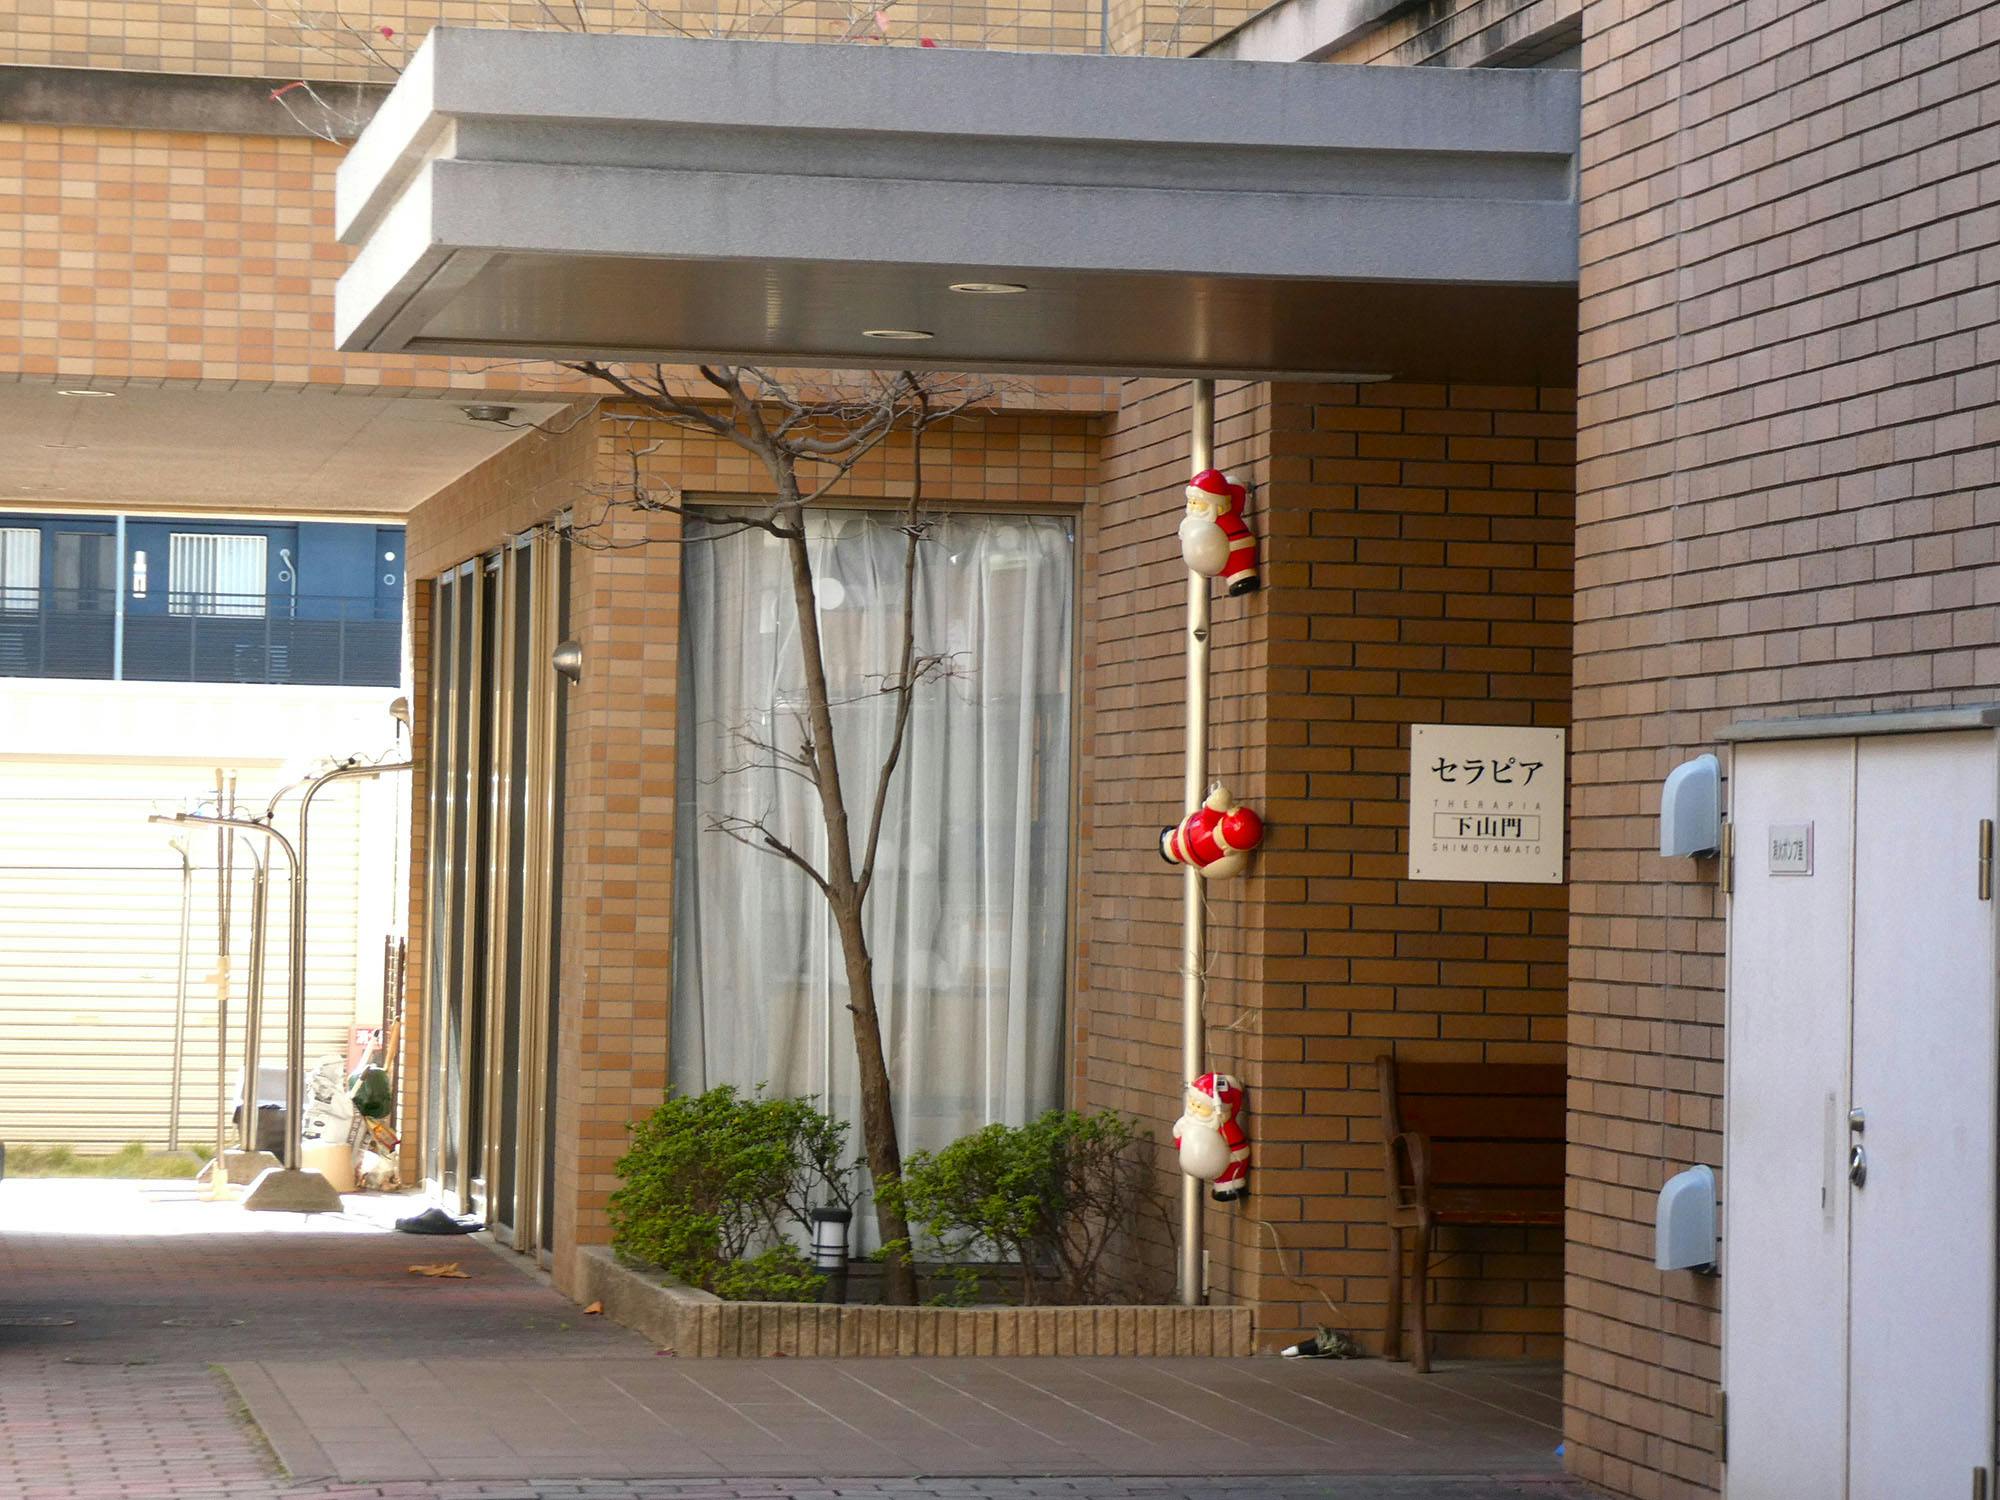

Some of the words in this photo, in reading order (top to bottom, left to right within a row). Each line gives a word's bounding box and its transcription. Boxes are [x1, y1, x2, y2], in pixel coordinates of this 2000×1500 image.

[1431, 757, 1545, 786] セラピア
[1433, 799, 1542, 811] THERAPIA
[1451, 816, 1522, 838] 下山門
[1432, 843, 1541, 855] SHIMOYAMATO
